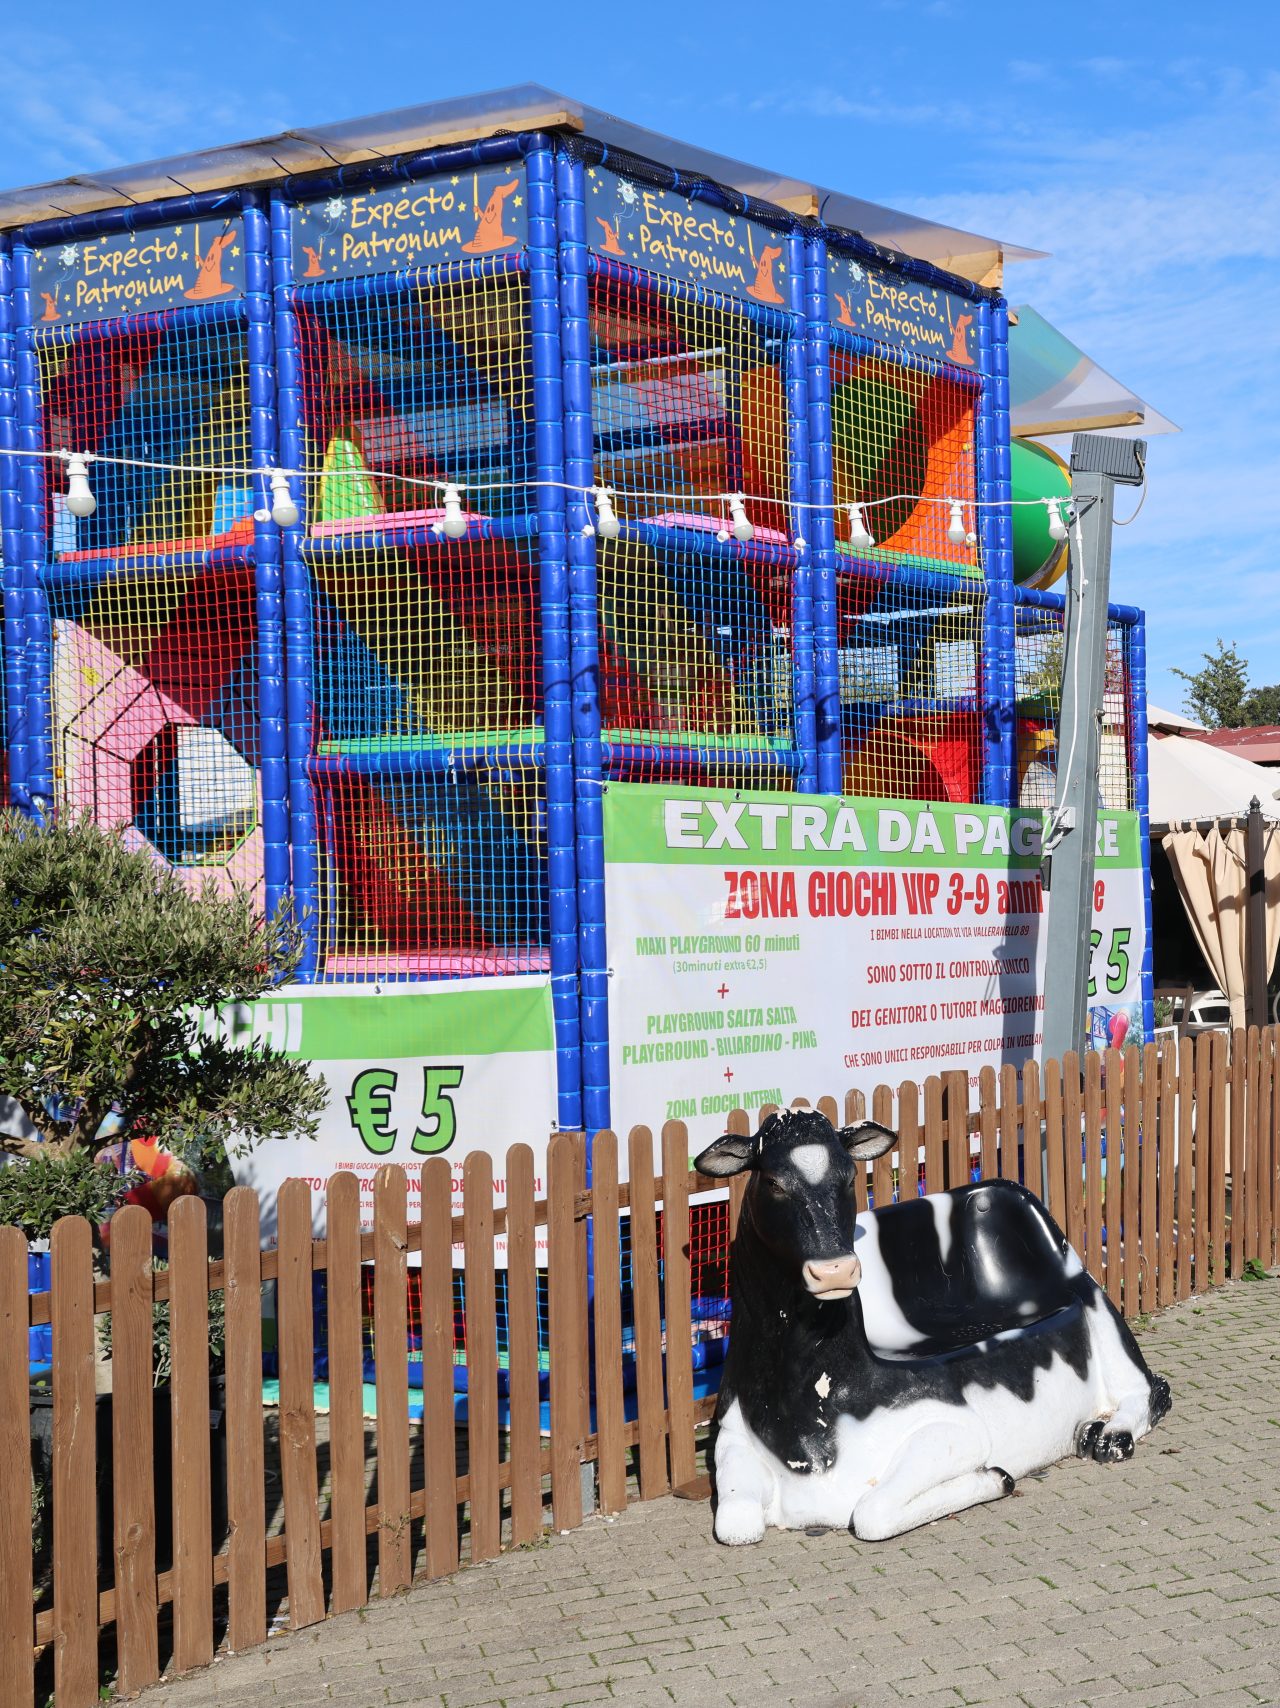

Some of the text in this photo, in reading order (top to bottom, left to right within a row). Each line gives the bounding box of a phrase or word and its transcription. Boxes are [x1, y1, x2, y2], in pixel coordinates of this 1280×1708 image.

[350, 187, 454, 229] Expecto
[643, 191, 735, 248] Expecto
[83, 237, 178, 276] Expecto
[342, 226, 462, 262] Patronum
[640, 225, 744, 284] Patronum
[76, 273, 184, 307] Patronum
[867, 273, 937, 318] Expecto
[865, 300, 946, 348] Patronum
[664, 799, 868, 852] EXTRA
[877, 808, 946, 855] DA
[724, 871, 798, 919] ZONA
[808, 871, 897, 918] GIOCHI
[901, 872, 940, 916] VIP
[947, 872, 990, 916] 3-9
[996, 873, 1044, 915] anni
[636, 934, 800, 956] MAXI PLAYGROUND 60 minuti
[876, 928, 899, 941] BIMBI
[901, 928, 922, 940] NELLA
[867, 957, 1030, 984] SONO SOTTO IL CONTROLLO UNICO
[647, 1006, 798, 1035] PLAYGROUND SALTA SALTA
[851, 1009, 872, 1028] DEI
[875, 1004, 928, 1026] GENITORI
[941, 1000, 977, 1019] TUTORI
[980, 995, 1045, 1017] MAGGIORENNI
[622, 1039, 709, 1066] PLAYGROUND
[715, 1033, 783, 1057] BILIARDINO
[792, 1030, 818, 1050] PING
[844, 1054, 860, 1068] CHE
[860, 1051, 883, 1067] SONO
[884, 1049, 908, 1064] UNICI
[910, 1042, 966, 1060] RESPONSABILI
[967, 1040, 982, 1054] PER
[984, 1037, 1005, 1052] COLPA
[666, 1088, 784, 1120] ZONA GIOCHI INTERNA
